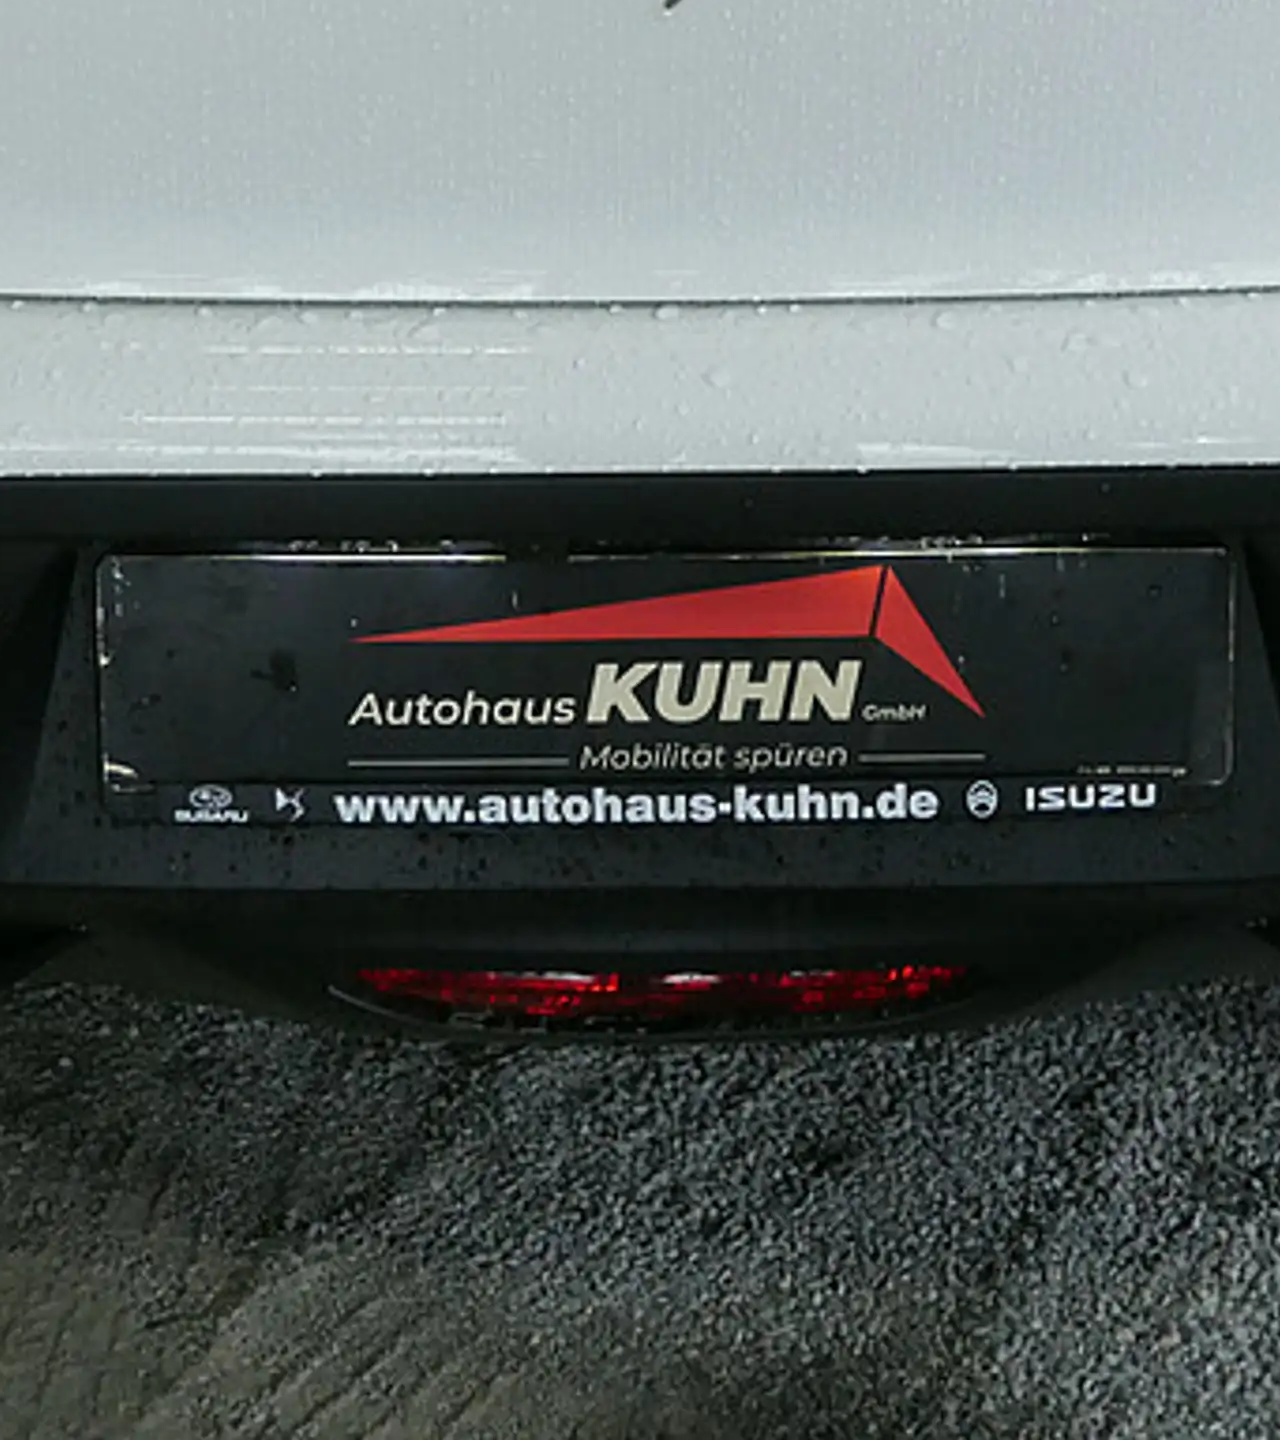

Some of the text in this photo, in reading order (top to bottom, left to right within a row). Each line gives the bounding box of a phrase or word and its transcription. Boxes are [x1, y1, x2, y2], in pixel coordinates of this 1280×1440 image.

[346, 659, 928, 727] Autohaus KUHN GmbH
[579, 742, 849, 773] Mobilität spüren
[333, 781, 939, 824] www.autohaus-kuhn.de
[1024, 782, 1157, 812] ISUZU
